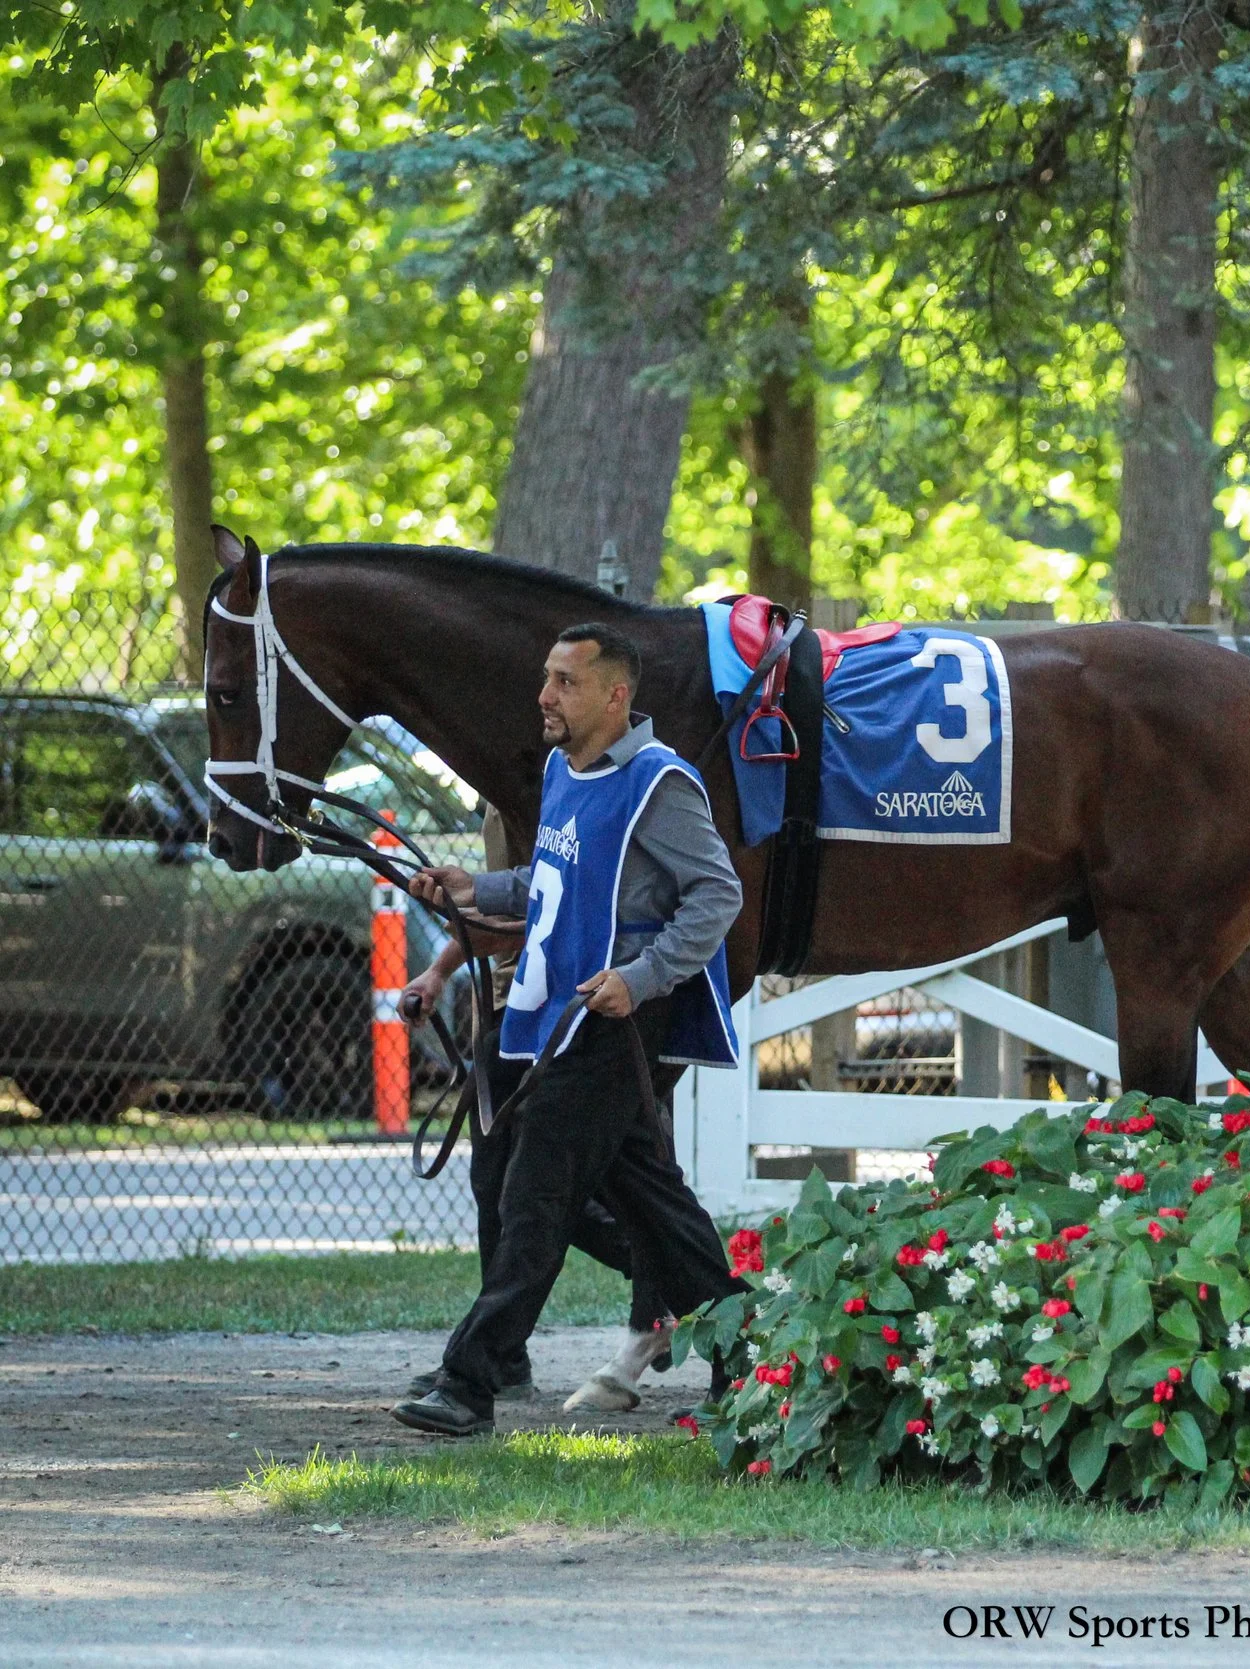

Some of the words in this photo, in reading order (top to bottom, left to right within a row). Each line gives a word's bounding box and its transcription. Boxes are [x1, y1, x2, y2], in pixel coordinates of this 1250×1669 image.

[910, 637, 992, 763] 3
[875, 791, 986, 817] SARATOGA
[506, 859, 564, 1012] 3
